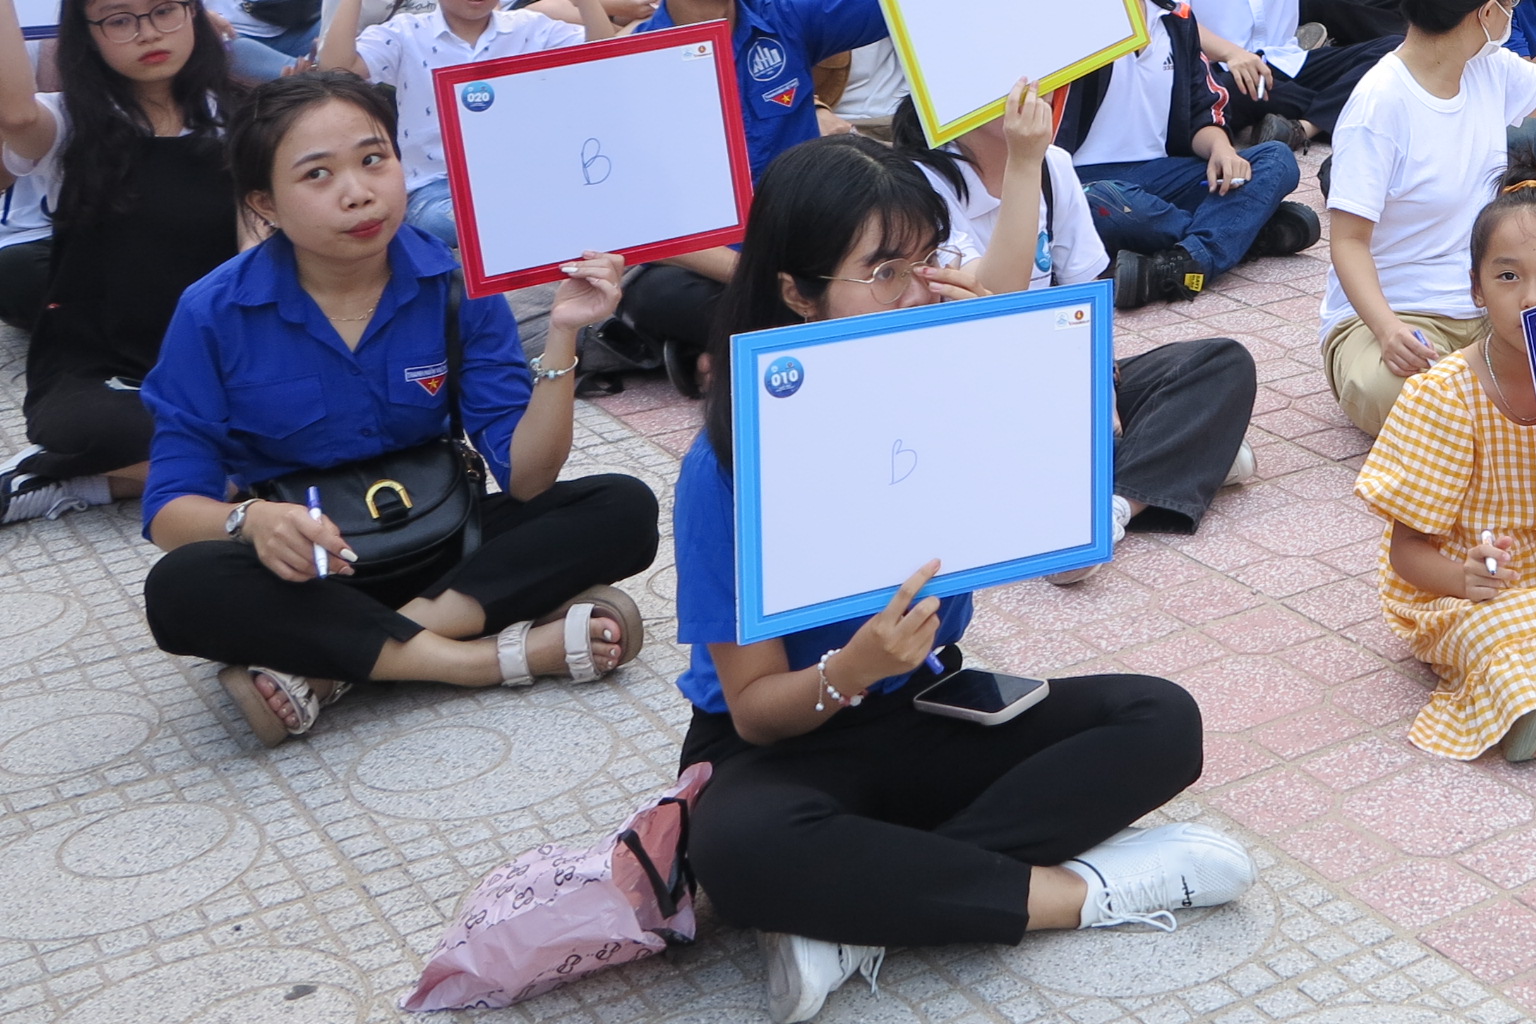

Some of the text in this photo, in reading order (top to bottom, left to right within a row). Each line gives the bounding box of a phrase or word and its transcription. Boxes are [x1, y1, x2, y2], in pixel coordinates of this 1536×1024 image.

[466, 91, 490, 103] 020
[580, 137, 612, 186] B
[771, 369, 799, 387] 010
[889, 438, 918, 486] B
